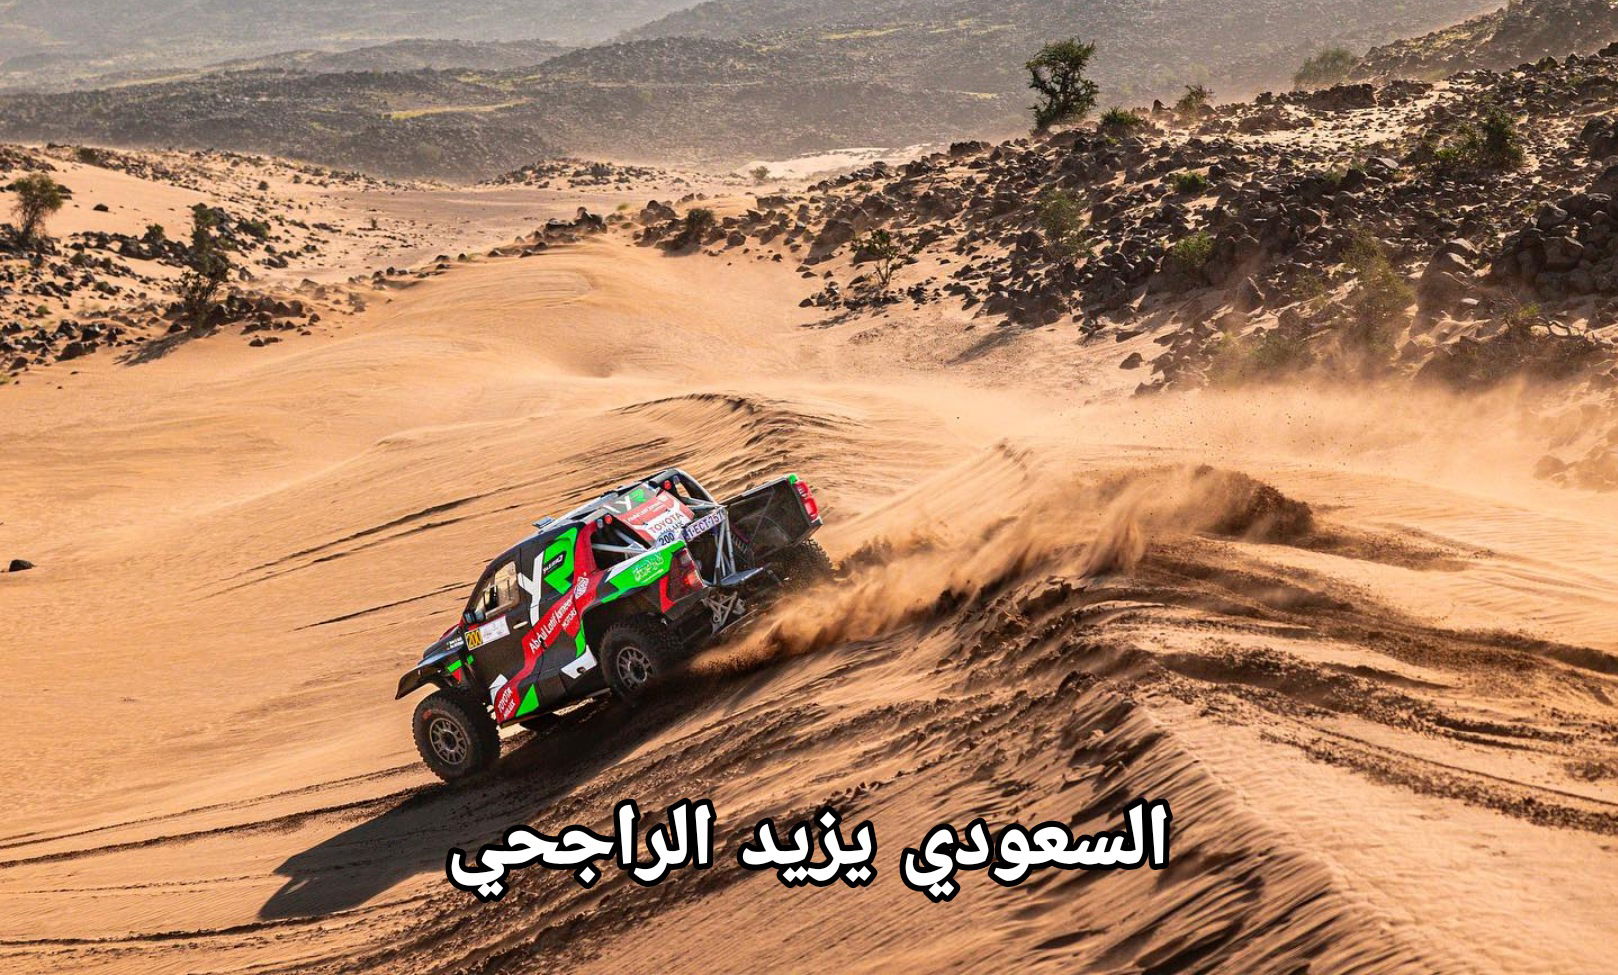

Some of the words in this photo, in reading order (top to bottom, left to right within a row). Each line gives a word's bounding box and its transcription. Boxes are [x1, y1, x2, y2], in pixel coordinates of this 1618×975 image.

[649, 512, 685, 534] TOYOTA
[658, 532, 675, 546] 200
[529, 627, 549, 654] Abdul
[498, 687, 513, 713] TOYOTA
